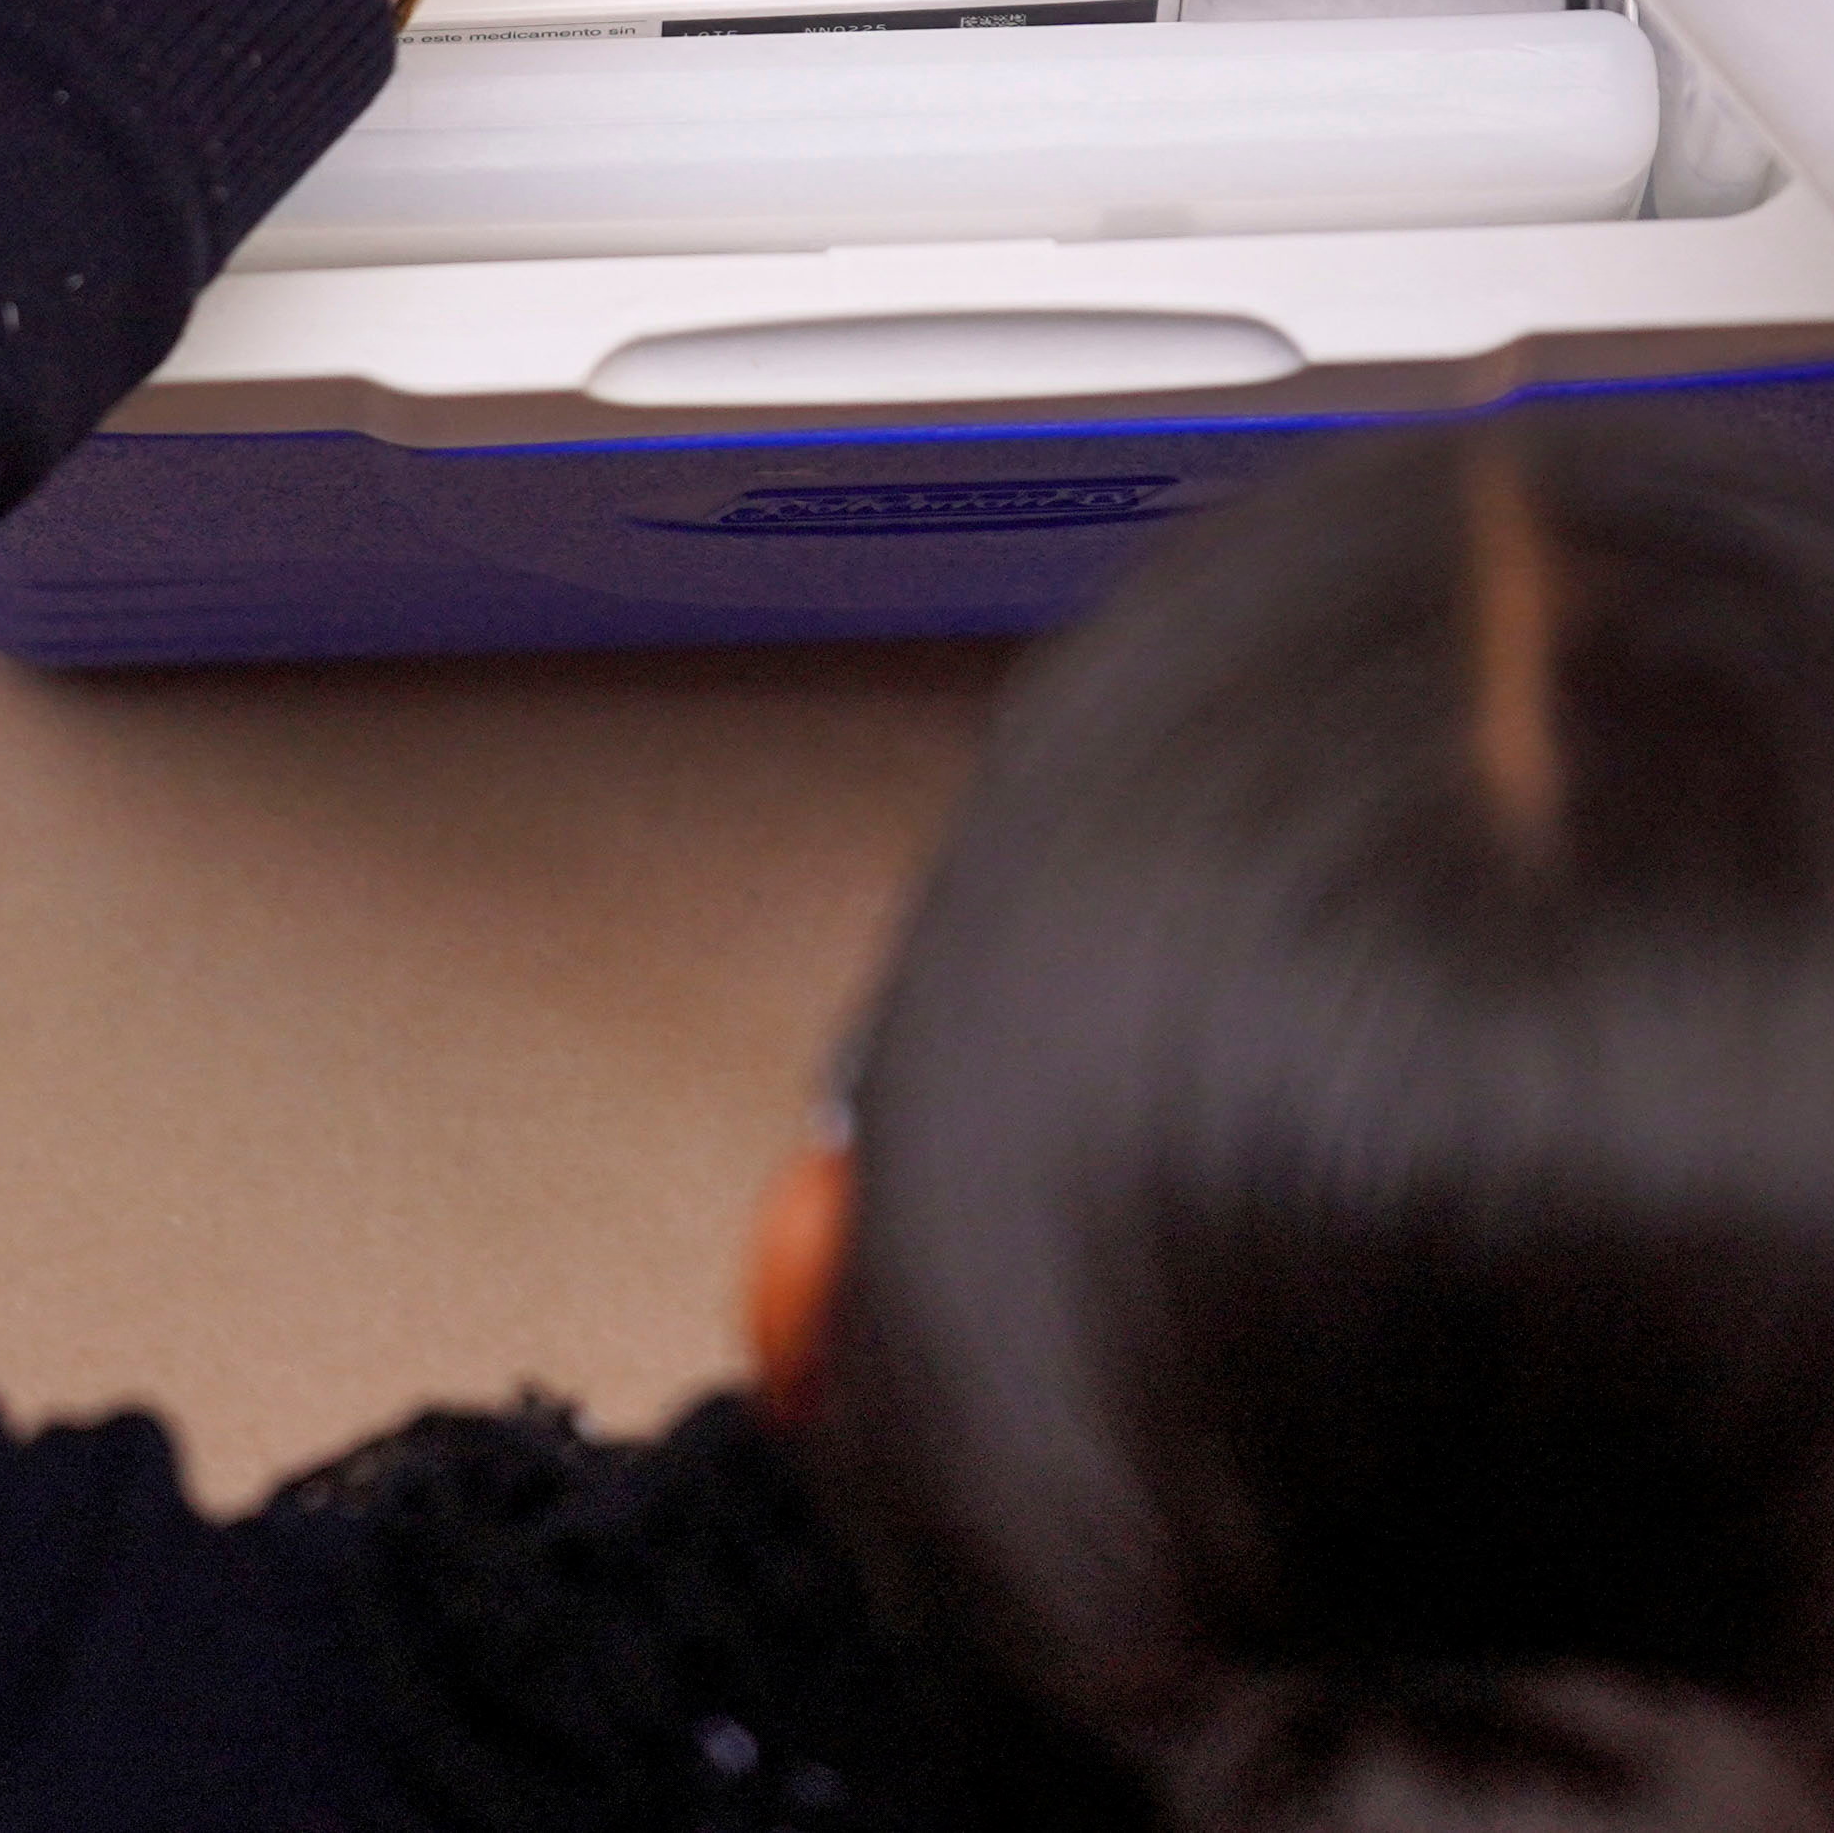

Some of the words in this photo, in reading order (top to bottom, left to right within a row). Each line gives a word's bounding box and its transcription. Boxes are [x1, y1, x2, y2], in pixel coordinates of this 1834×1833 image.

[421, 33, 462, 43] este
[469, 27, 602, 42] medicamento
[608, 26, 636, 36] sin
